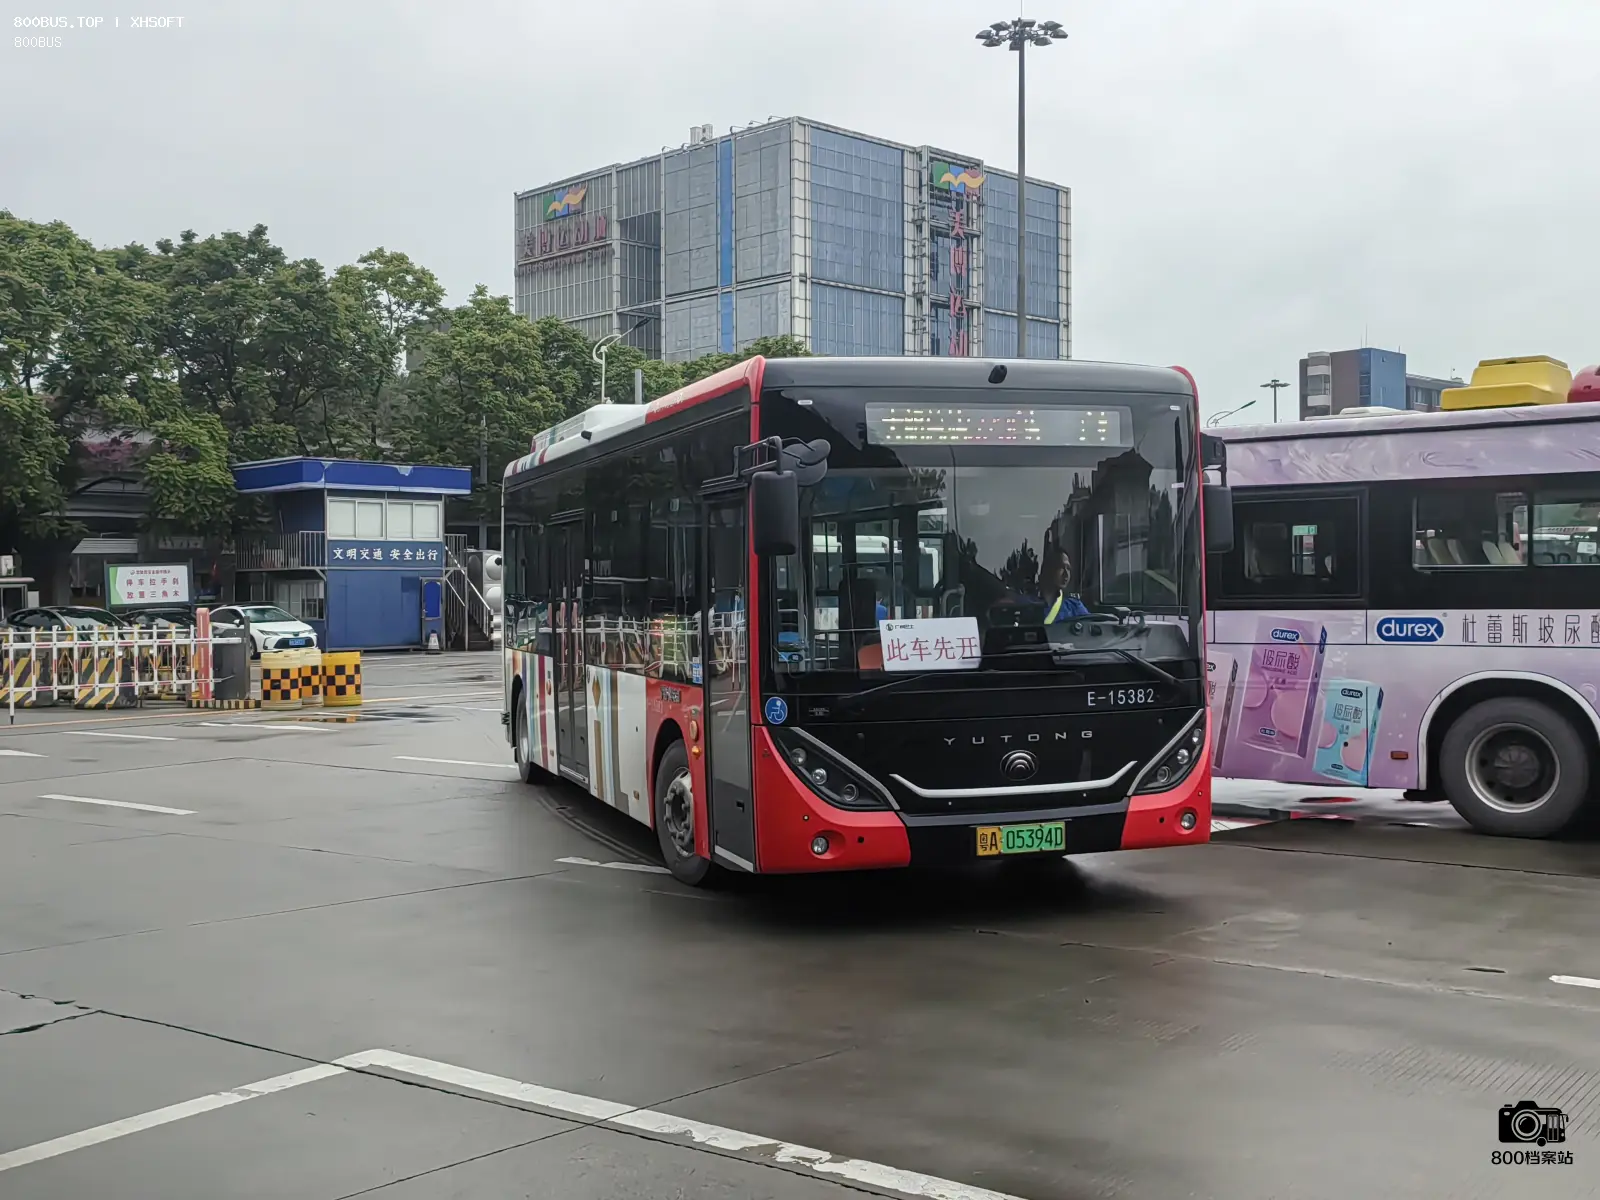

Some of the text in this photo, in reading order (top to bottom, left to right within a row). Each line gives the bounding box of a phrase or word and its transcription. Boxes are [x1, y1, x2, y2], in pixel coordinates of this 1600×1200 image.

[333, 547, 439, 561] 文明交通 安全出行
[1273, 629, 1299, 641] durex
[1381, 619, 1439, 640] durex
[886, 636, 979, 662] 此车先开
[1262, 649, 1301, 671] 玻尿酸
[1087, 688, 1155, 706] E-15382
[944, 730, 1093, 745] YUTONG
